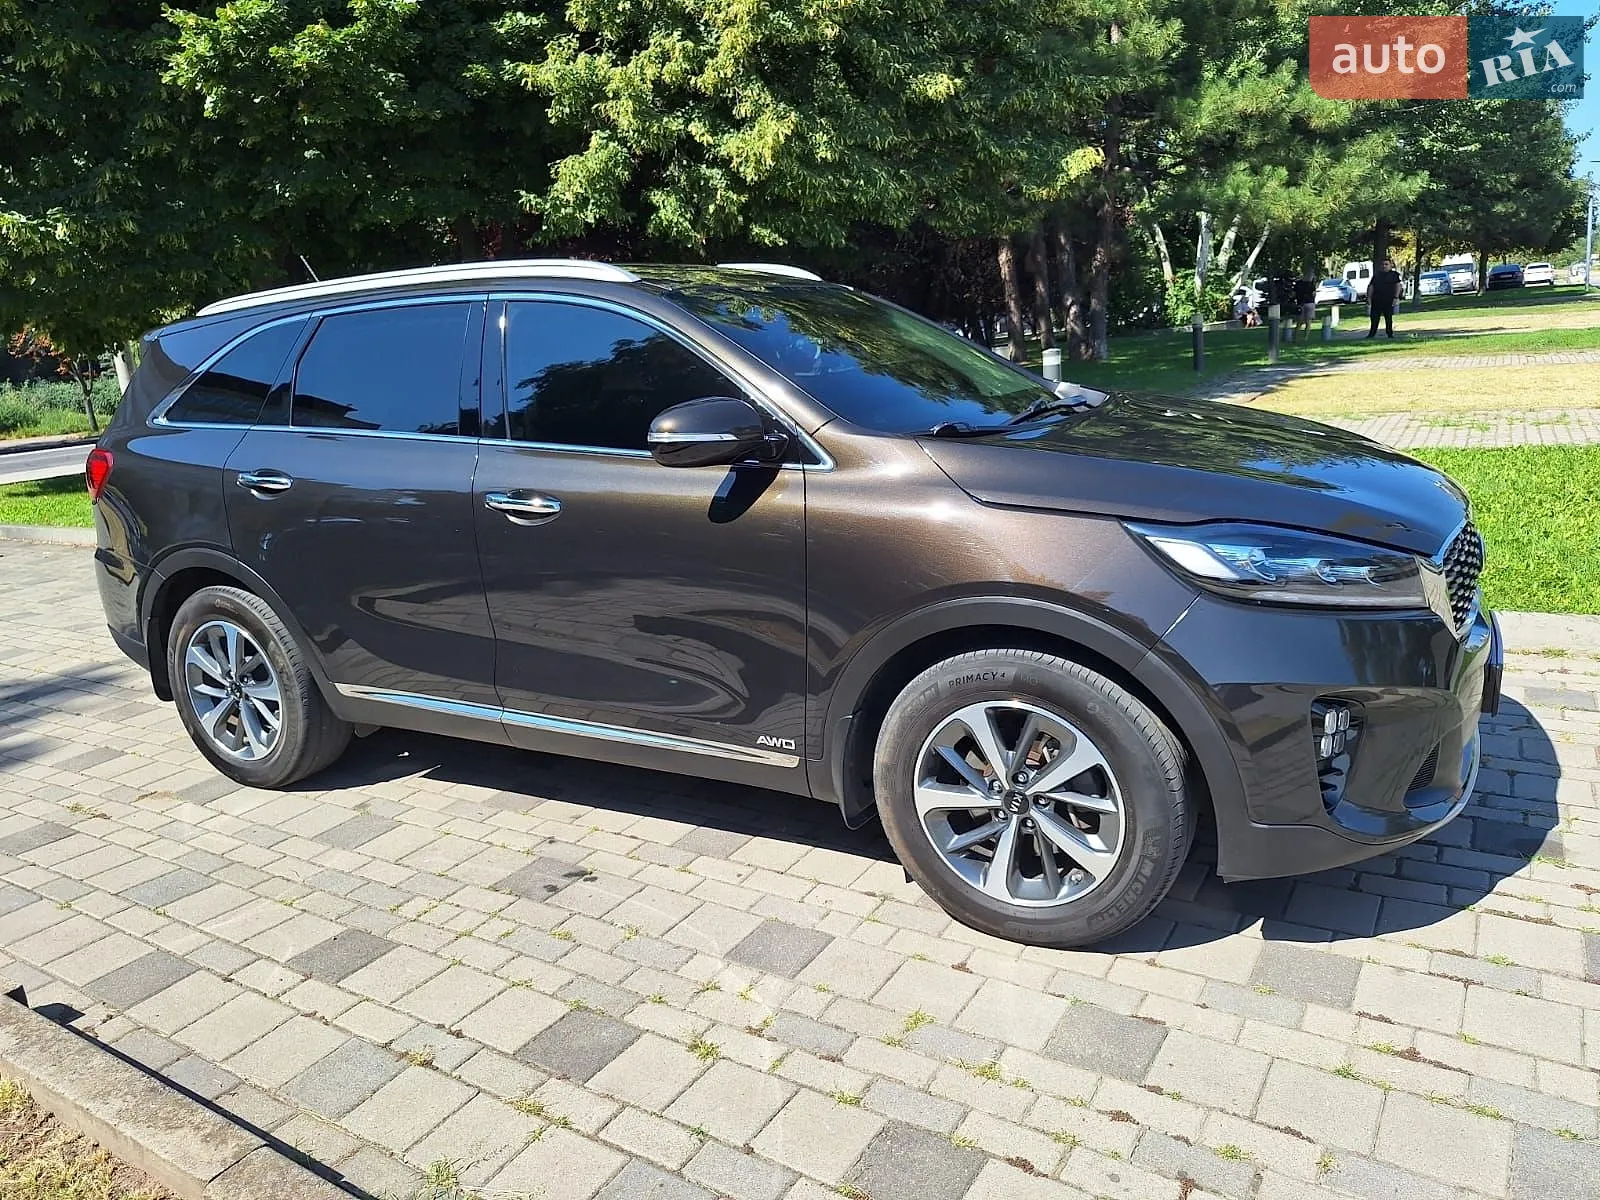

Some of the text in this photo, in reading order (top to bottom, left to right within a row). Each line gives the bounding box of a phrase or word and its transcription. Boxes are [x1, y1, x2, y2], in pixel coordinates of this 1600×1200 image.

[948, 671, 998, 688] PRIMACY
[756, 735, 796, 750] AWD
[1009, 793, 1024, 812] KIA
